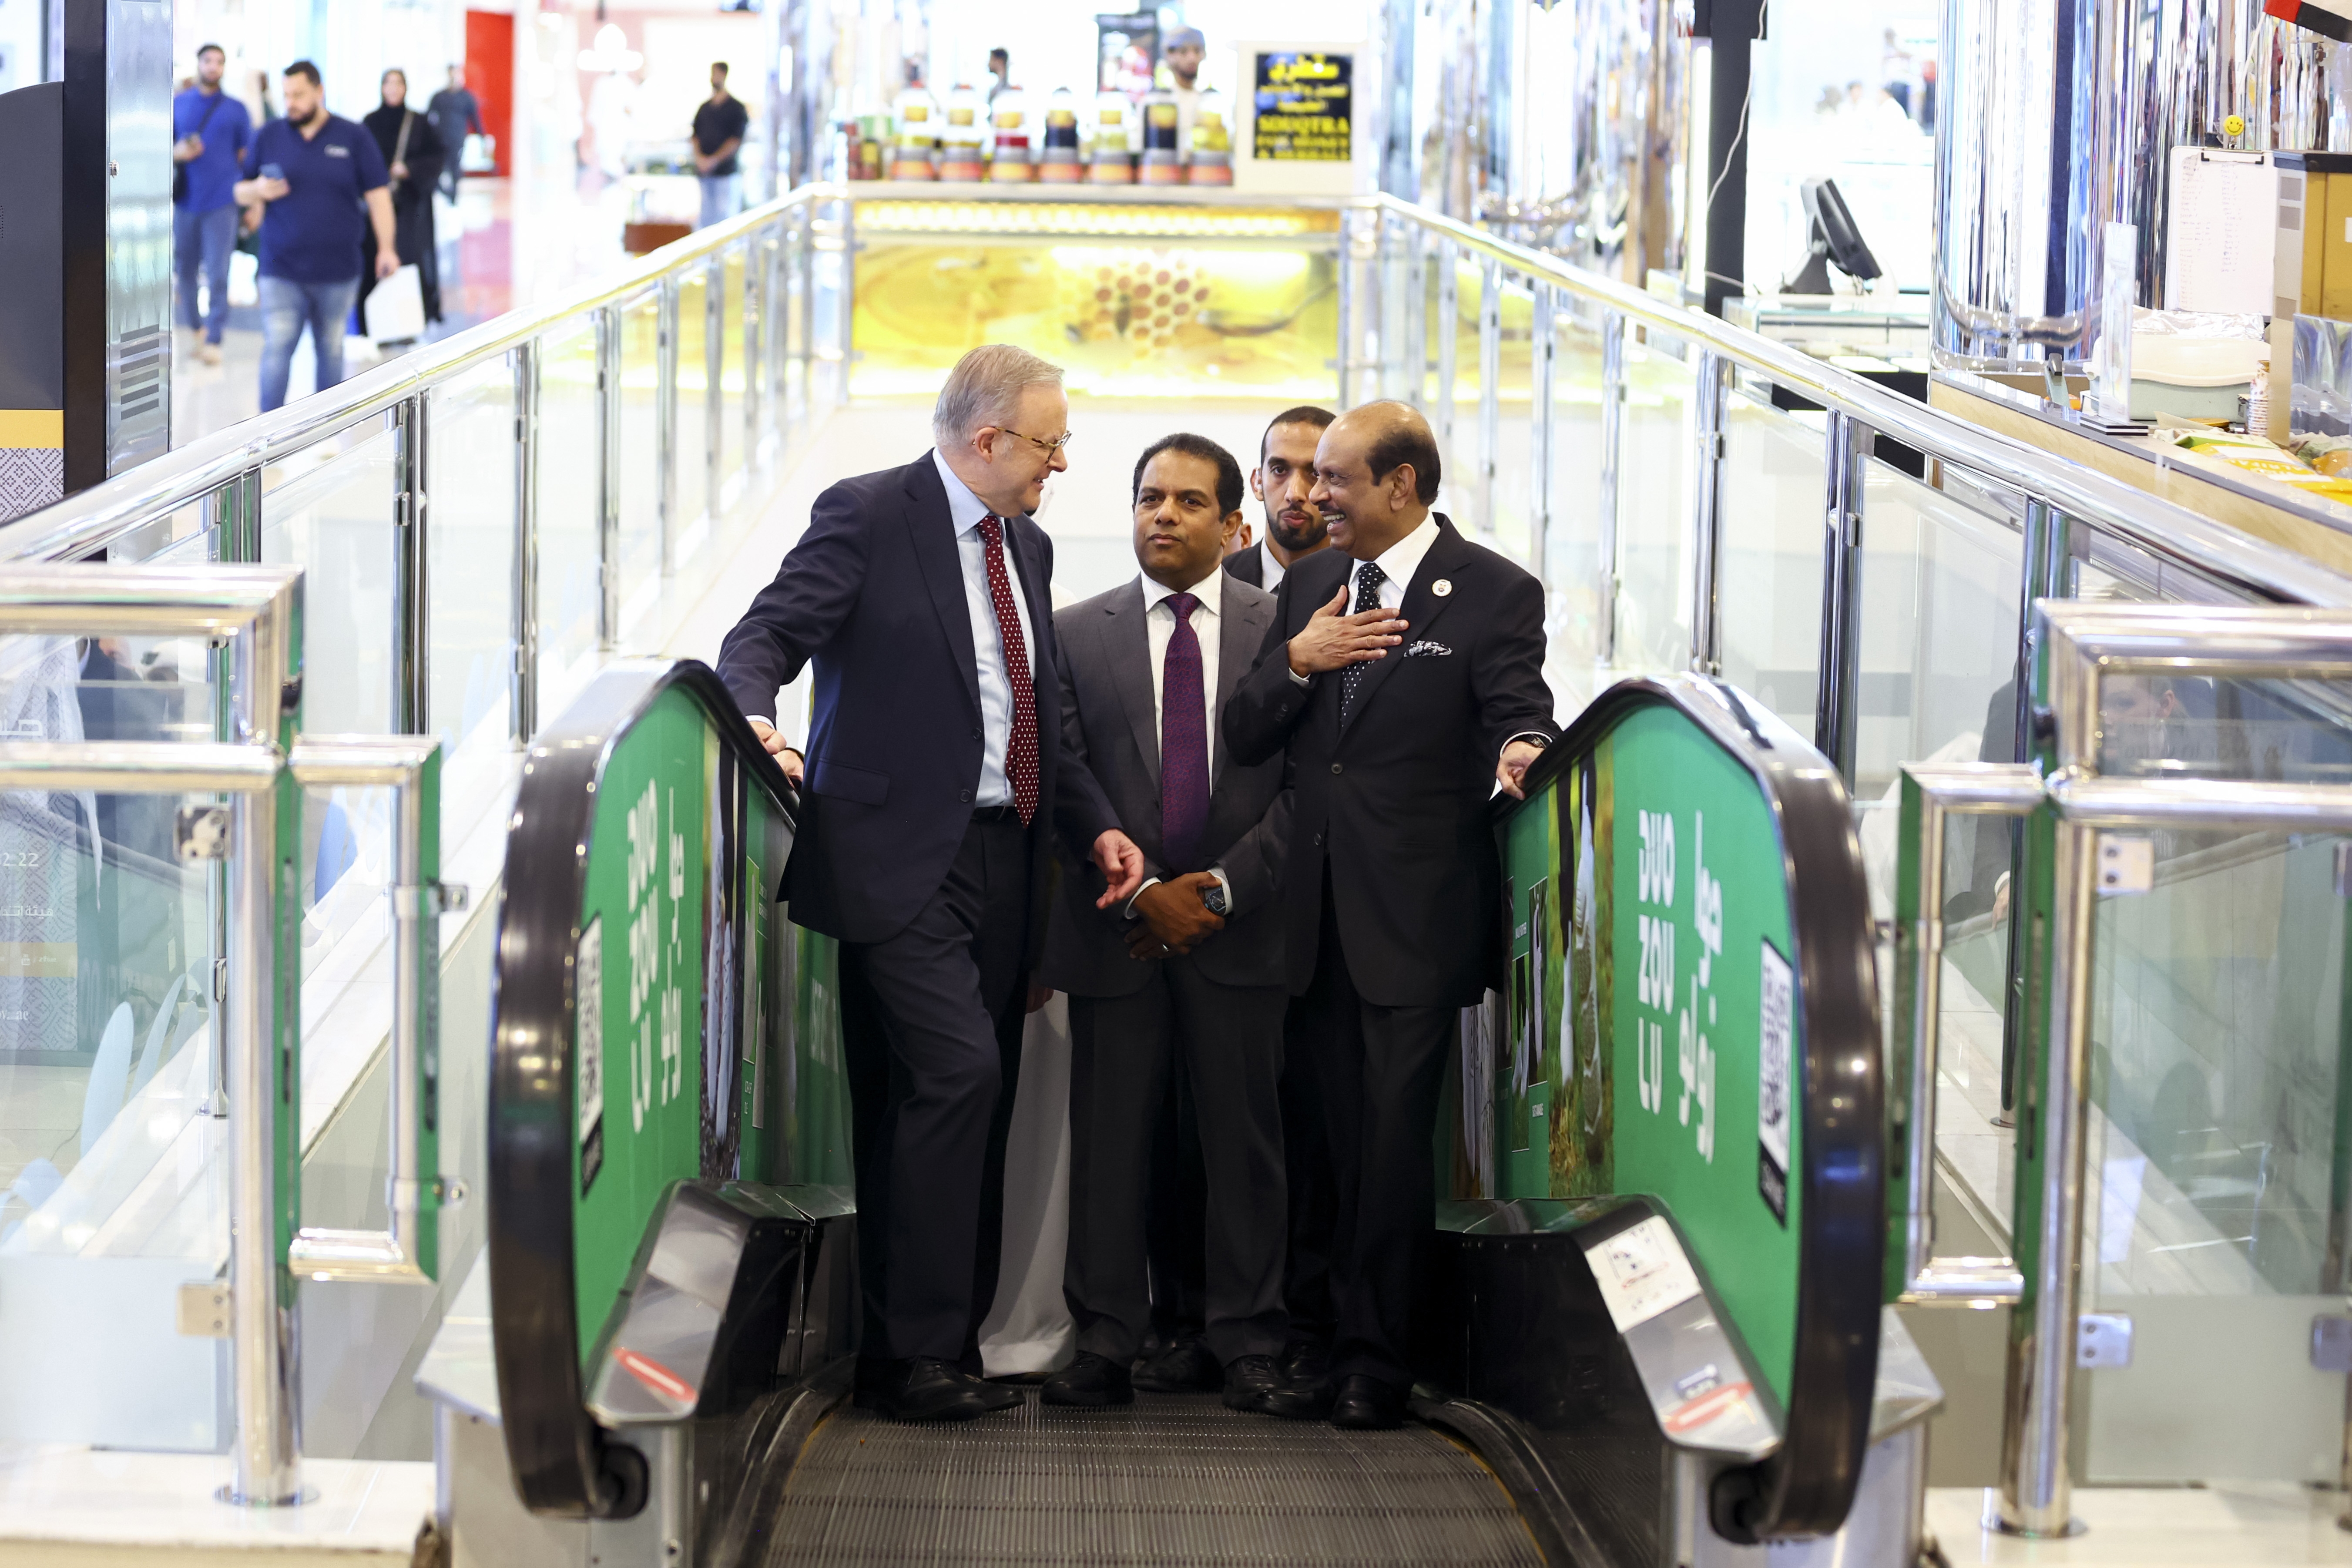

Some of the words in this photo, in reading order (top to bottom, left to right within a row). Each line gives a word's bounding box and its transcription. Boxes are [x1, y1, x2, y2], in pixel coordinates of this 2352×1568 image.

[1638, 809, 1676, 908] DUO
[628, 885, 659, 1024] ZOU
[1637, 914, 1675, 1014] ZOU
[631, 1011, 652, 1133] LU
[1637, 1016, 1663, 1115] LU
